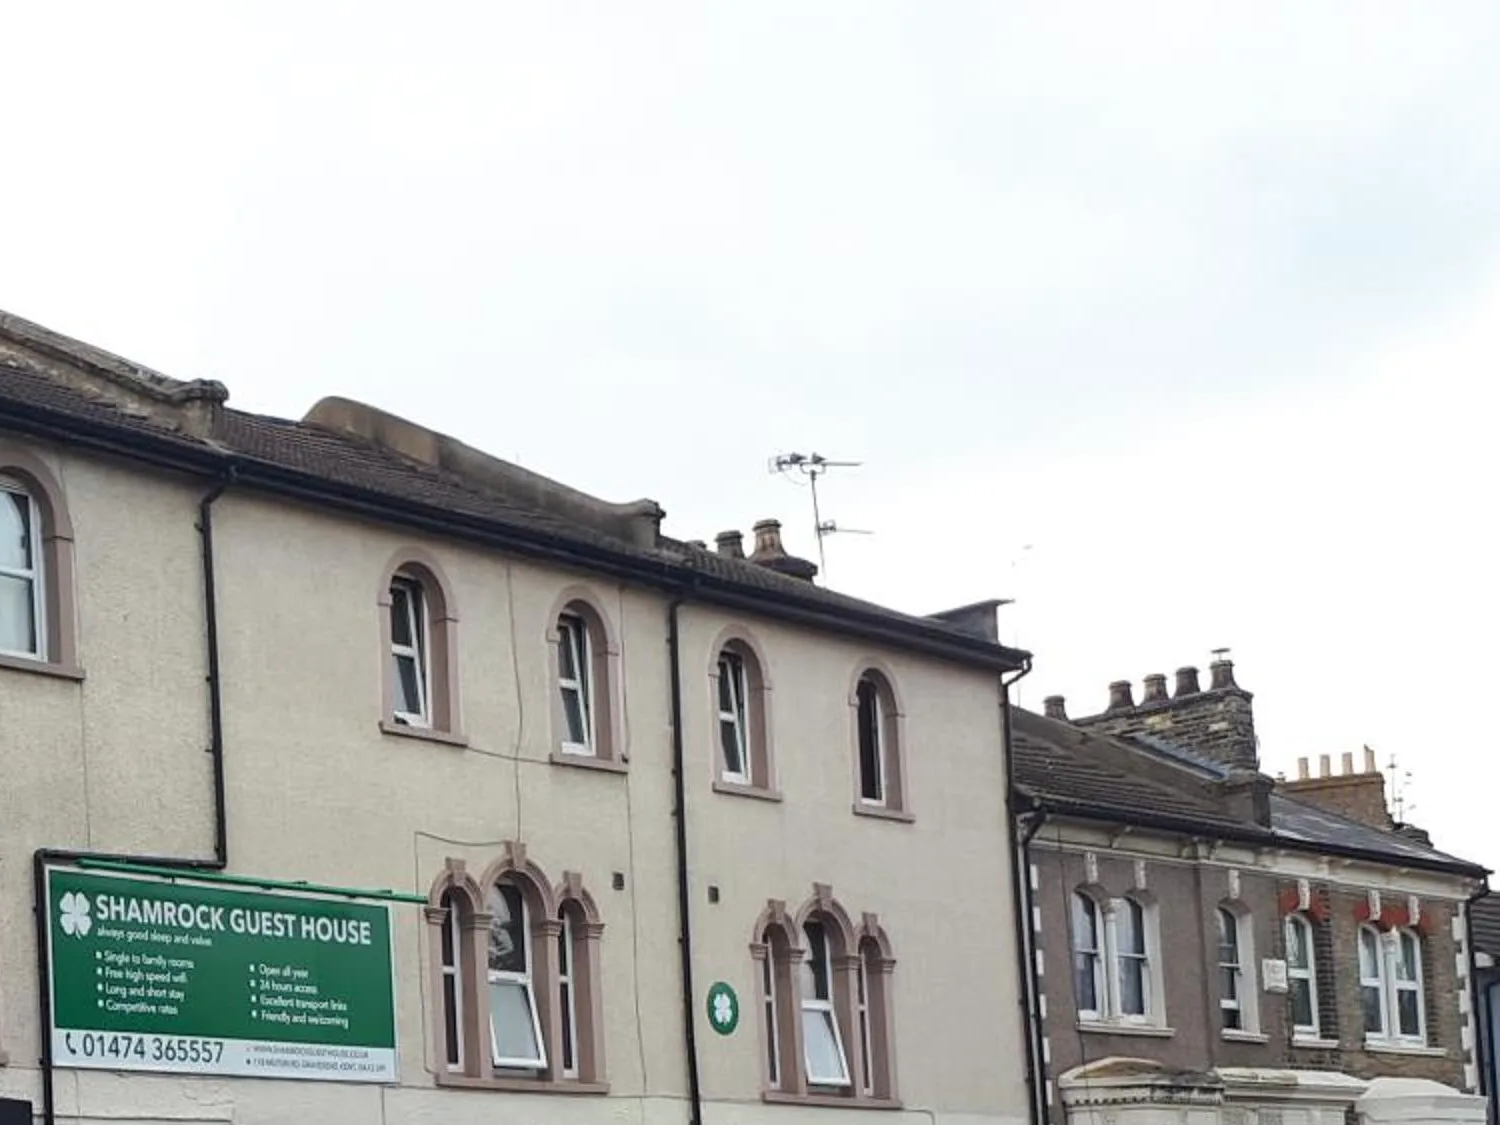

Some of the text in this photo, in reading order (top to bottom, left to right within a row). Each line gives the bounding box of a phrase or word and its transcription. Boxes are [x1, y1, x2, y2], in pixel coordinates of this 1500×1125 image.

[95, 895, 372, 945] SHAMROCK GUEST HOUSE
[126, 929, 148, 942] good
[174, 934, 189, 945] and
[104, 950, 194, 969] Single to family rooms
[105, 966, 124, 979] Free
[125, 968, 144, 982] high
[146, 970, 170, 984] speed
[259, 963, 309, 980] Open all year
[105, 982, 184, 1002] Long and short stay
[260, 979, 318, 994] 24 hours access
[106, 999, 156, 1014] Competitive
[260, 994, 294, 1007] Excellent
[295, 998, 328, 1011] transport
[261, 1009, 349, 1029] Friendly and welcoming
[83, 1033, 224, 1063] 01474 365557
